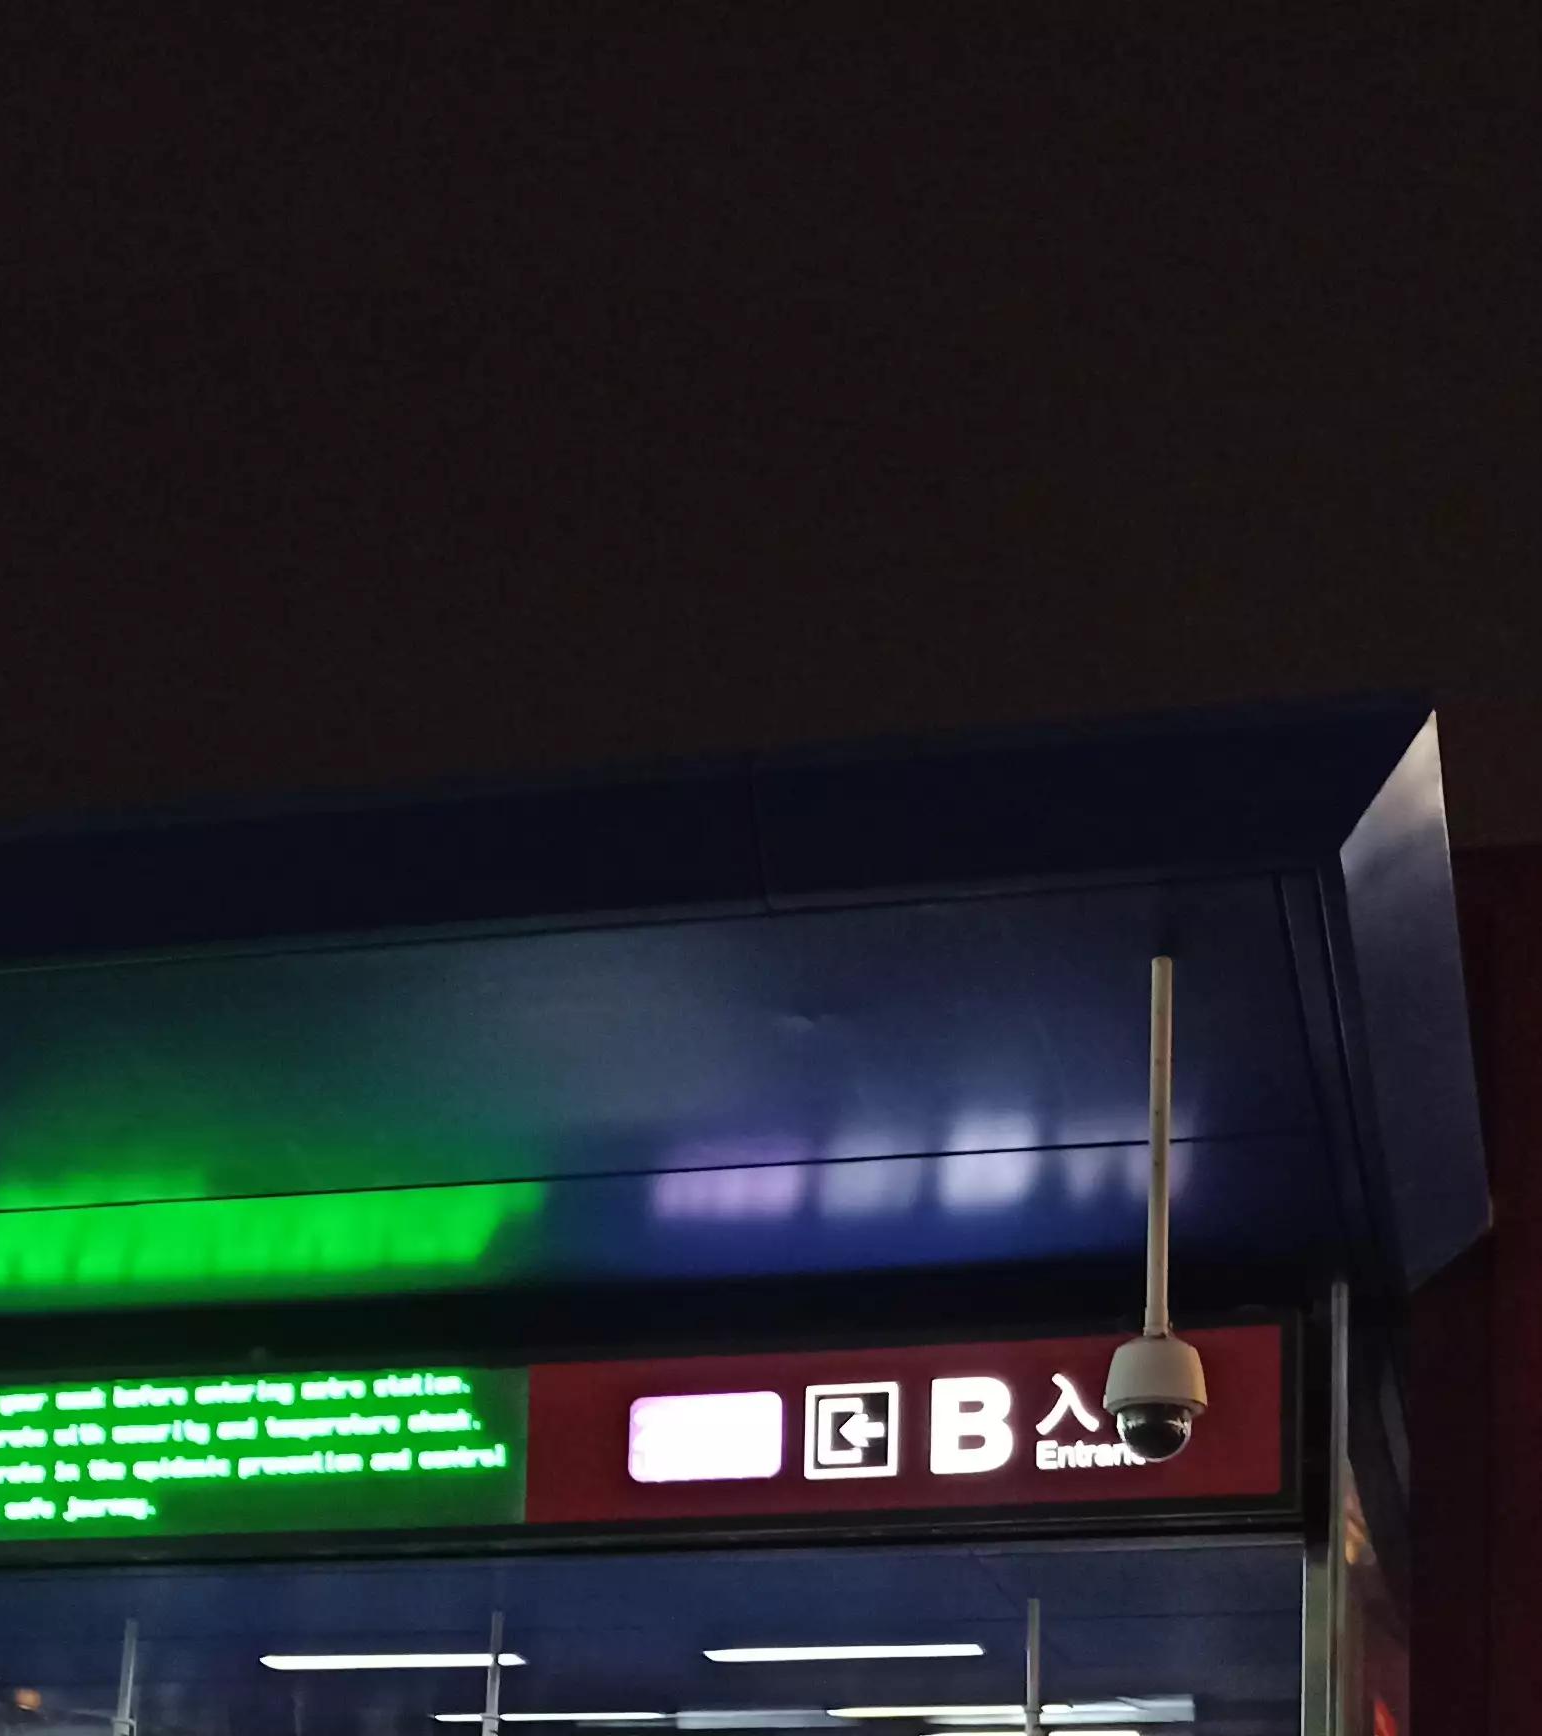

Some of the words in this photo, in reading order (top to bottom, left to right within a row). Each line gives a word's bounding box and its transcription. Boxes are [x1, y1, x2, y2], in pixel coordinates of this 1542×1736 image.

[930, 1377, 1014, 1474] B
[1036, 1373, 1099, 1436] 入
[1036, 1440, 1146, 1470] Entran
